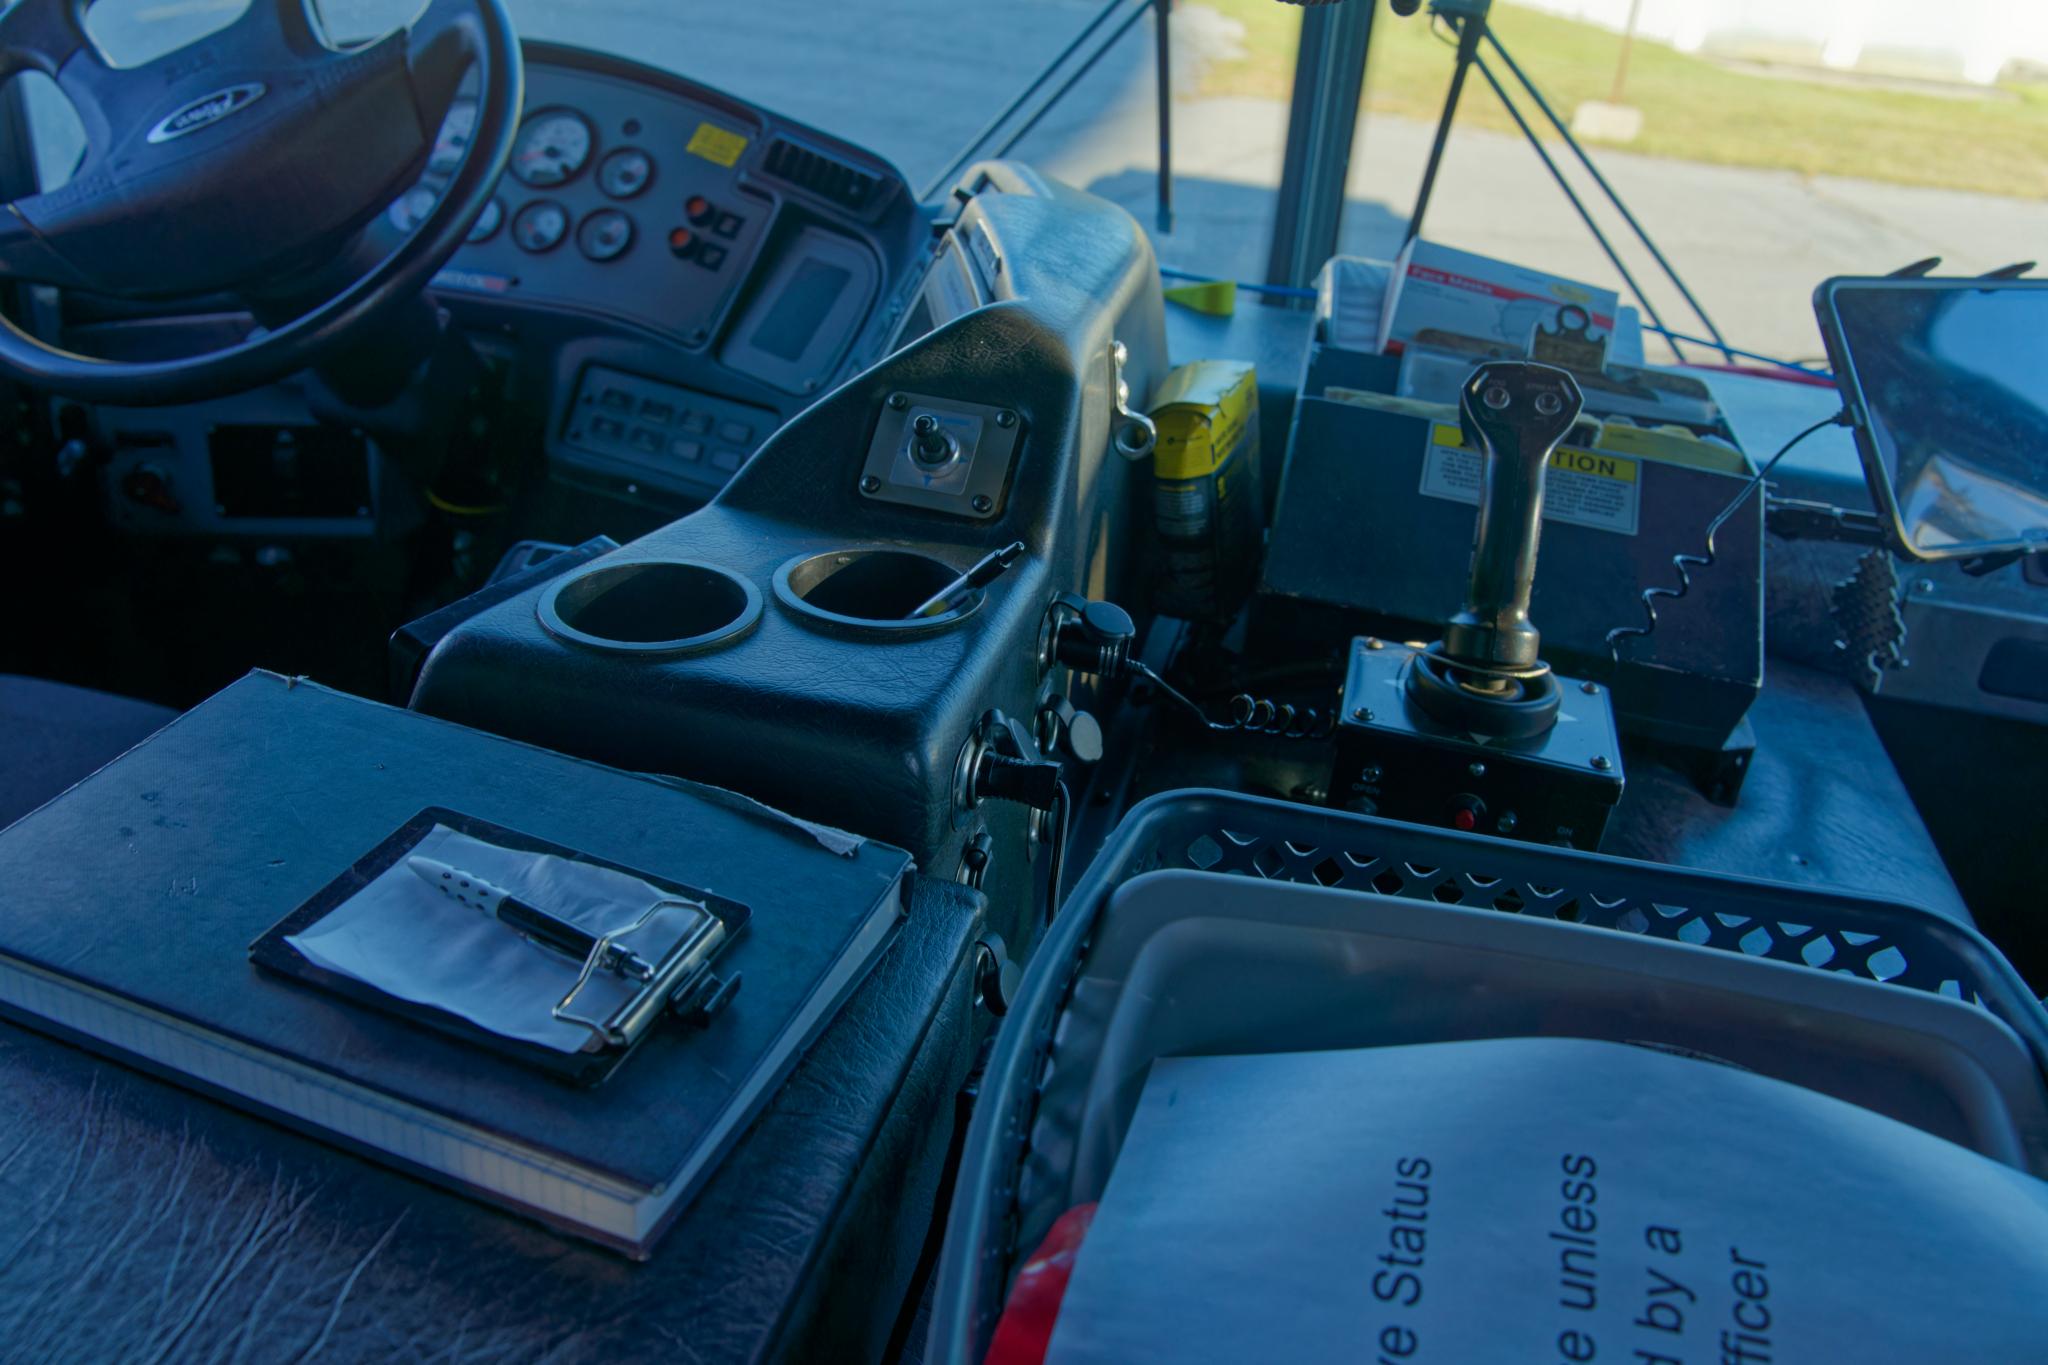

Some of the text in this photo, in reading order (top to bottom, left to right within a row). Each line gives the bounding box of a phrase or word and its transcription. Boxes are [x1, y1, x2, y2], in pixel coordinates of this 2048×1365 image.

[1411, 267, 1444, 283] Face
[1449, 275, 1493, 294] Masks
[1352, 782, 1381, 796] OPEN
[1556, 825, 1574, 837] ON
[1371, 1156, 1431, 1306] Status
[1549, 1153, 1596, 1311] unless
[1645, 1225, 1682, 1255] a
[1633, 1267, 1697, 1334] by
